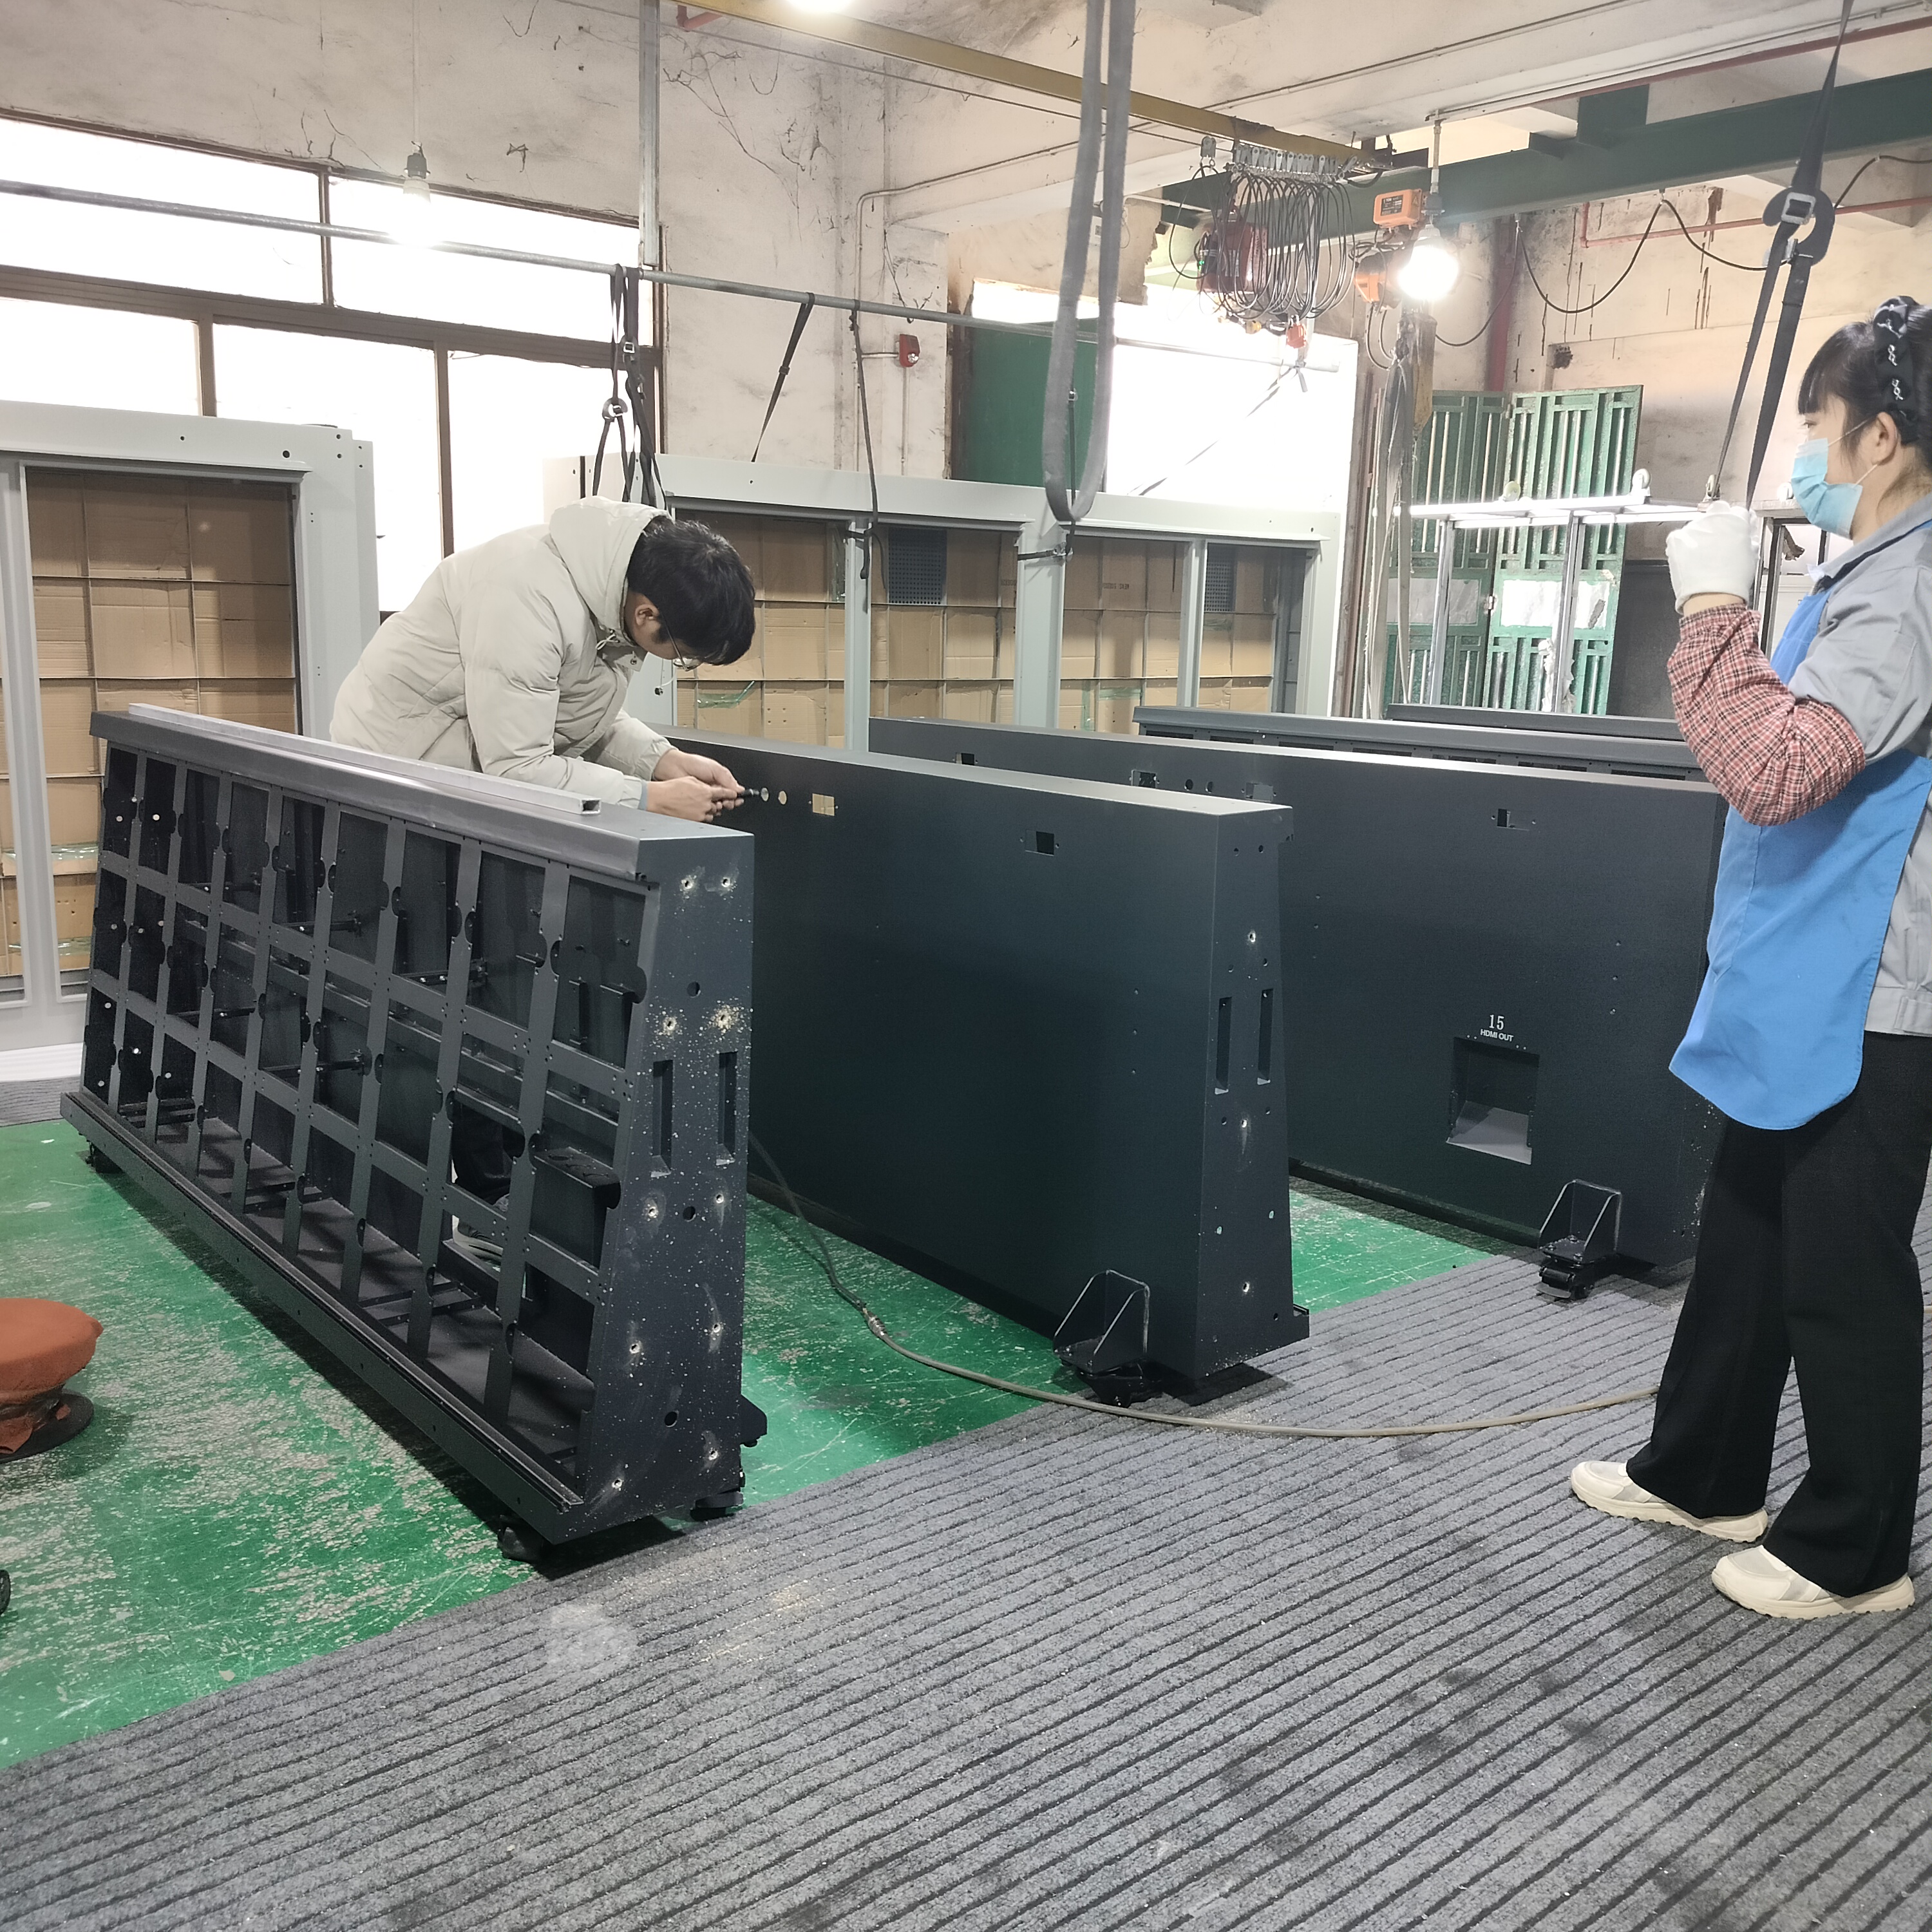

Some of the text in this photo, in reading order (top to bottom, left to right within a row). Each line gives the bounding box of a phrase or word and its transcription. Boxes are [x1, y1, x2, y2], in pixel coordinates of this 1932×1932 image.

[1489, 1014, 1504, 1030] 15
[1480, 1028, 1514, 1042] HDMI OUT
